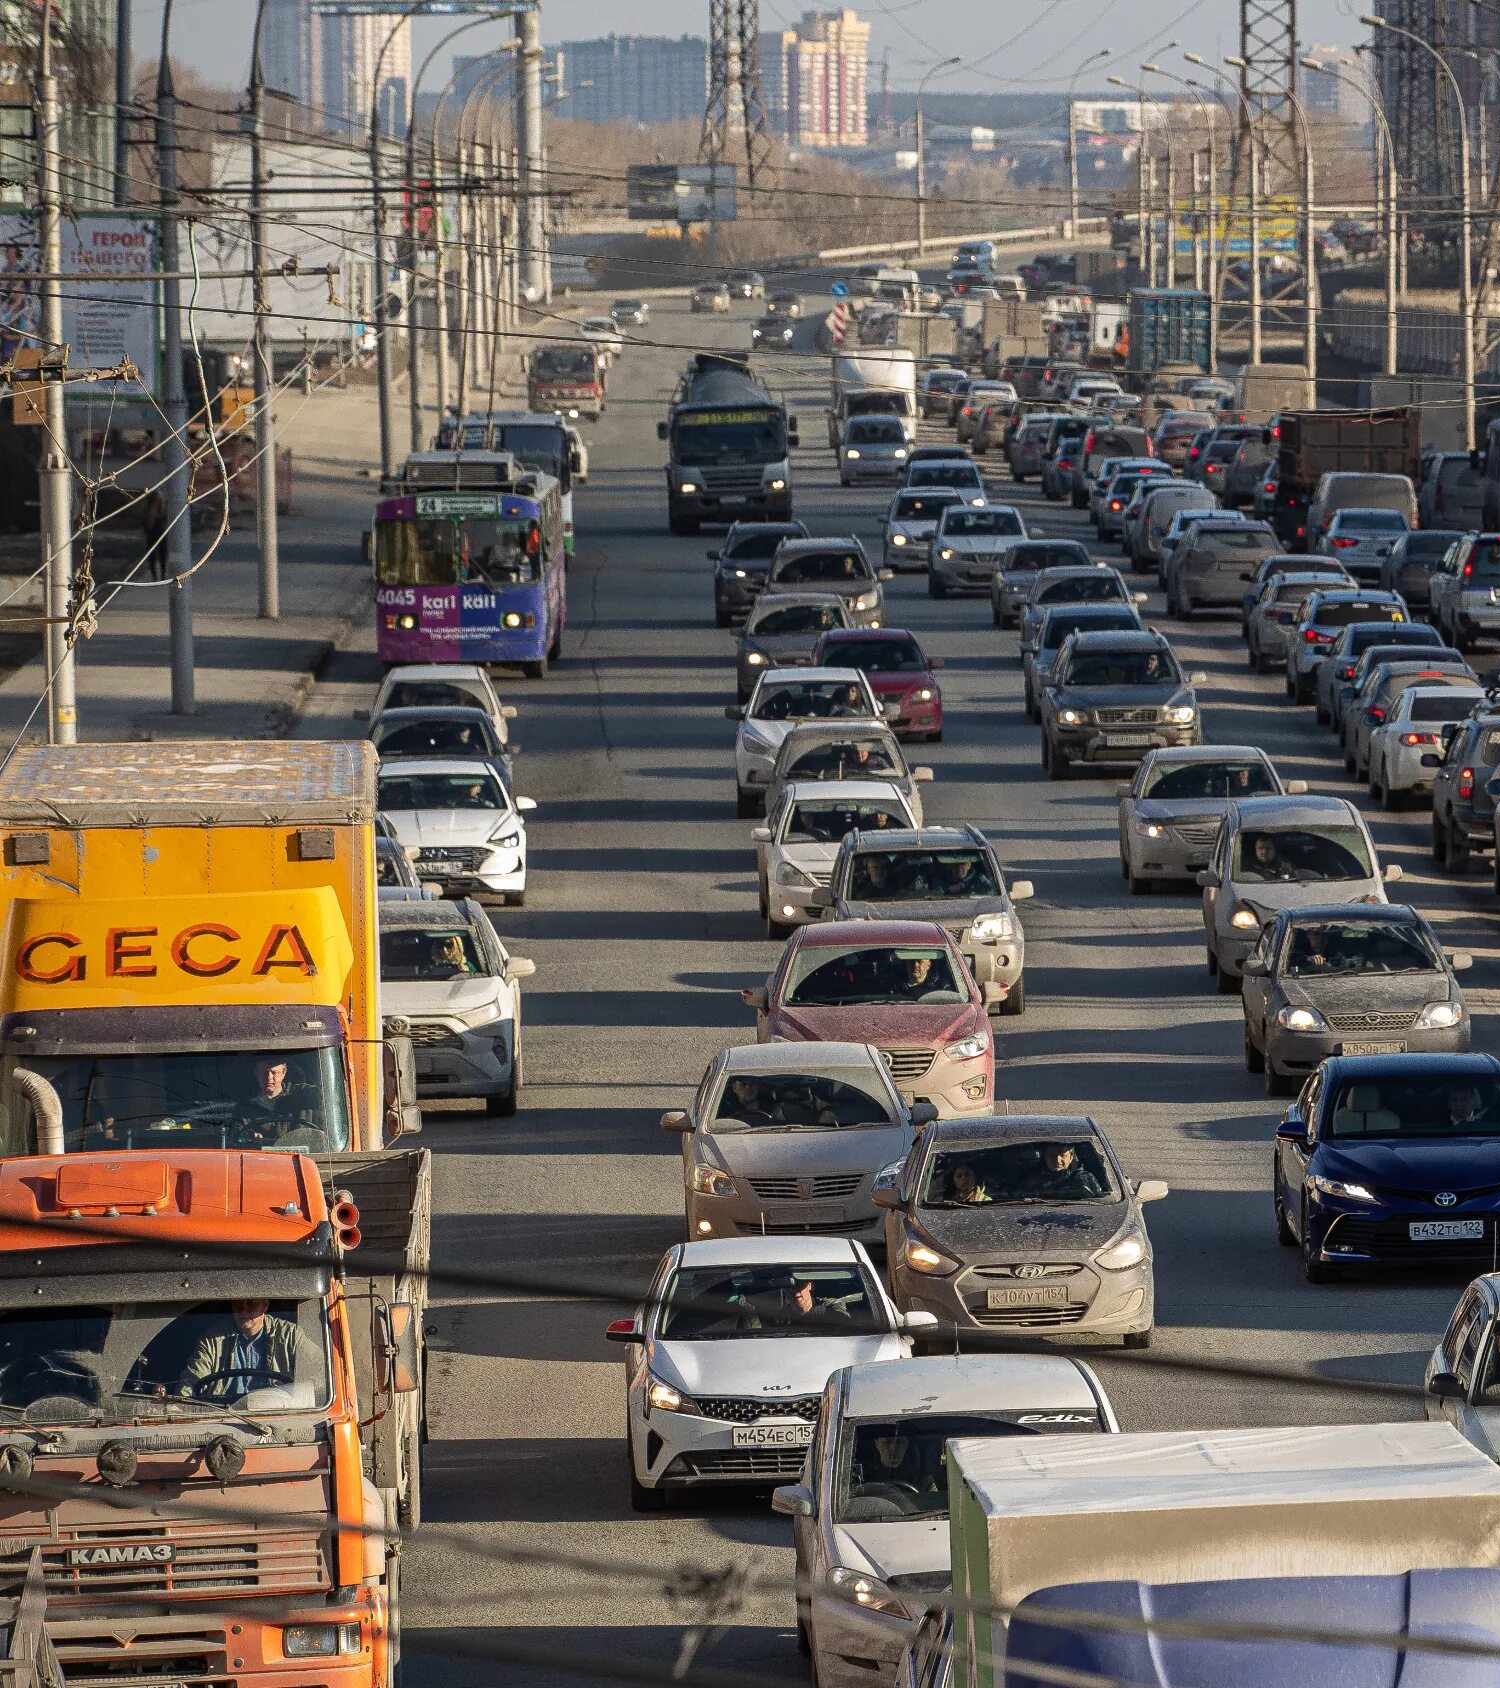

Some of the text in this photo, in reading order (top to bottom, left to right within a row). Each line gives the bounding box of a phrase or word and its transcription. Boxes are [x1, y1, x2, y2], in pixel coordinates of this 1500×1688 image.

[1413, 1223, 1460, 1236] В432ТС
[1018, 1414, 1097, 1424] Edix
[737, 1428, 795, 1443] М454ЕС
